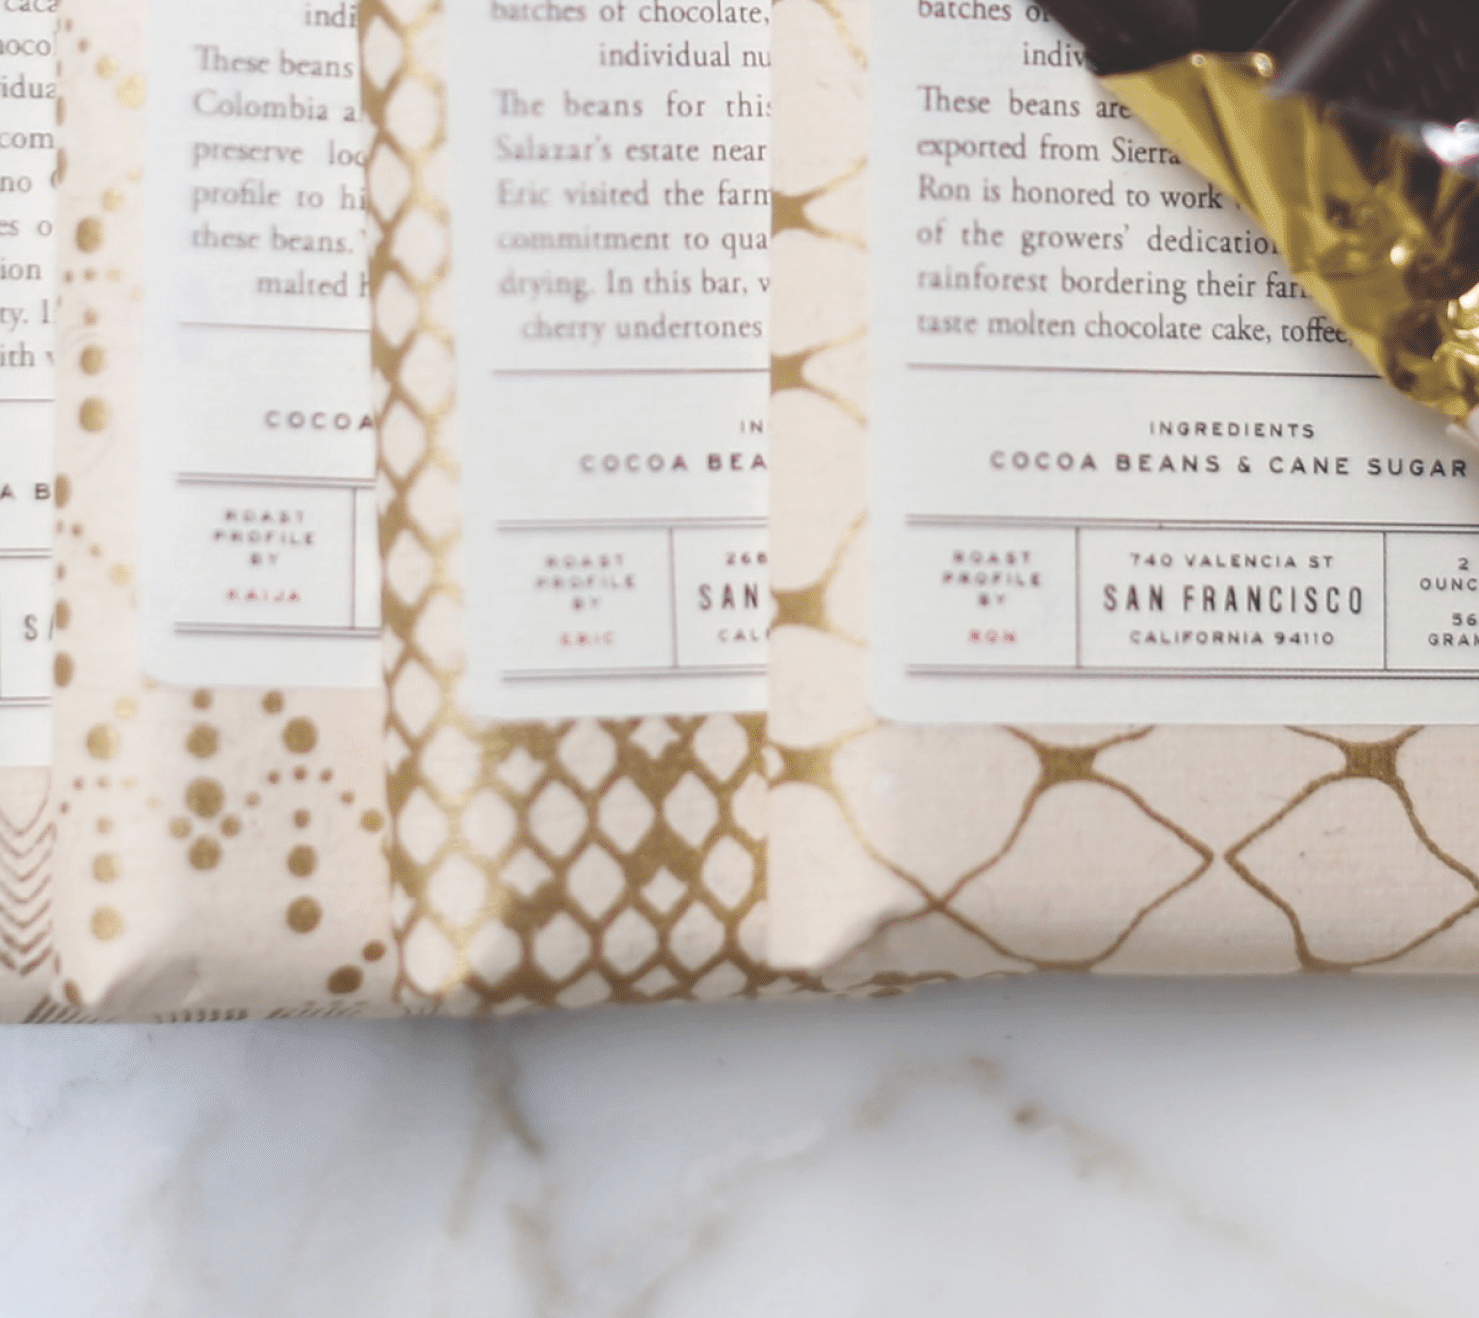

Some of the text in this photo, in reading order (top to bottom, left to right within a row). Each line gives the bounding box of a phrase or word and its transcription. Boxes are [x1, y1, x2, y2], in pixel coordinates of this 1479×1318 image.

[278, 48, 354, 79] beans
[599, 39, 731, 68] individual
[190, 88, 329, 122] Colombia
[666, 89, 706, 118] for
[916, 85, 1081, 118] These beans
[191, 141, 305, 169] preserve
[624, 142, 767, 162] estate near
[915, 132, 1027, 167] exported
[1039, 132, 1100, 162] from
[562, 177, 705, 207] visited the
[917, 172, 1226, 210] Ron is honored to work
[255, 269, 349, 299] malted
[917, 263, 1257, 306] rainforest bordering their
[614, 311, 763, 340] undertones
[916, 308, 1272, 343] taste molten chocolate cake,
[1149, 420, 1315, 440] INGREDIENTS
[578, 452, 688, 475] COCOA
[988, 449, 1467, 478] COCOA BEANS & CANE SUGAR
[1130, 552, 1333, 569] 740 VALENCIA ST
[1457, 556, 1469, 571] 2
[697, 583, 759, 611] SAN
[1102, 583, 1363, 616] SAN FRANCISCO
[1451, 611, 1478, 627] 56
[1129, 629, 1335, 646] CALIFORNIA 94110
